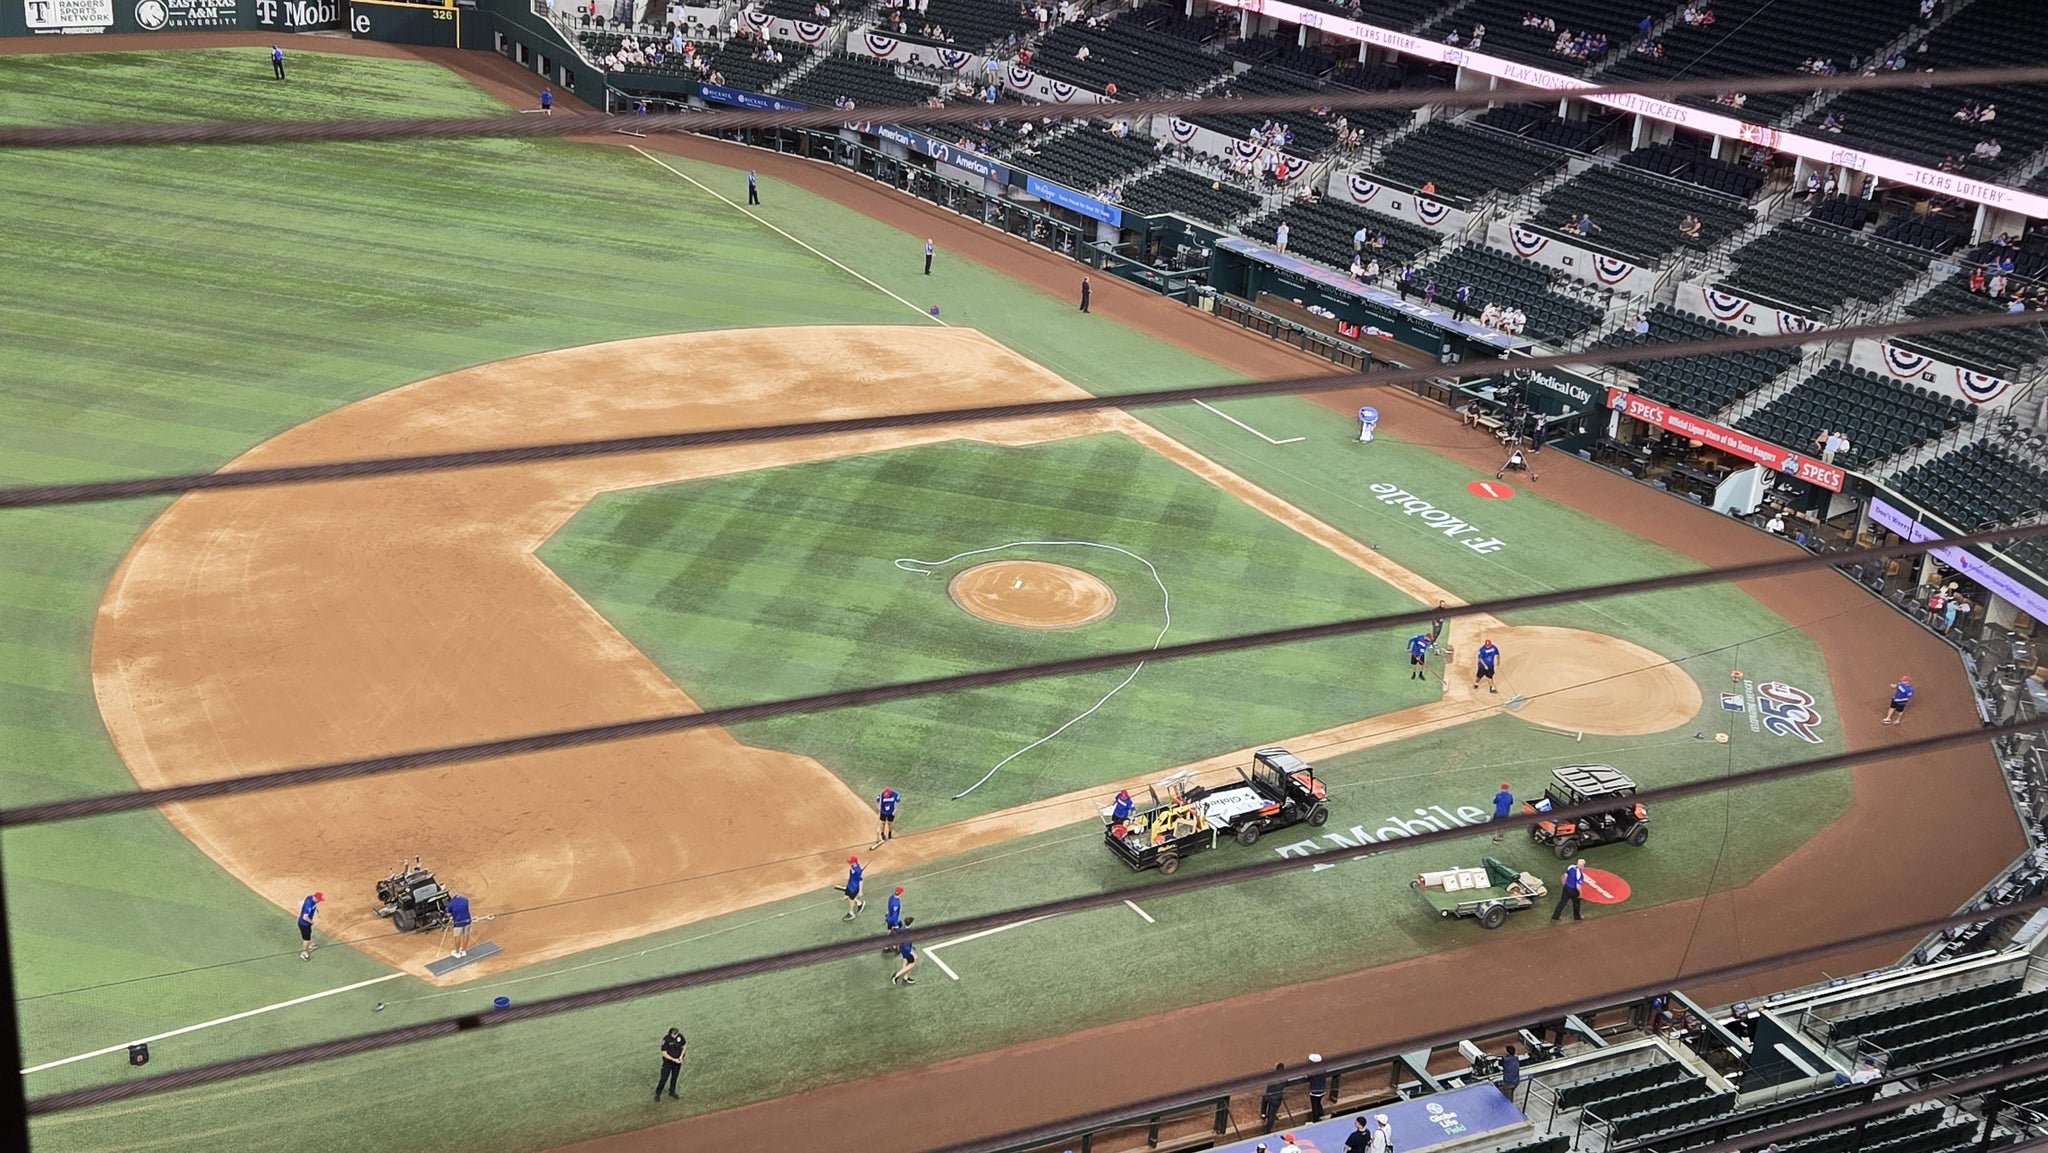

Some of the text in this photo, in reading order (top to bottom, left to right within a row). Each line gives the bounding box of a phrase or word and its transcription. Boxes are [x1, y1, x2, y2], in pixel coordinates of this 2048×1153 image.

[59, 0, 105, 8] RANGERS
[60, 7, 97, 15] SPORTS
[168, 0, 236, 8] EAST TEXAS
[60, 14, 110, 22] NETWORK
[187, 7, 218, 19] A&M
[432, 9, 453, 21] 326
[168, 18, 237, 27] UNIVERSITY
[1354, 28, 1415, 50] TEXAS LOTTERY
[1504, 64, 1531, 79] PLAY
[1638, 98, 1688, 123] TICKETS
[877, 125, 909, 146] American
[955, 154, 989, 176] American
[1914, 171, 2006, 202] TEXAS LOTTERY
[1530, 370, 1592, 405] Medical City
[1630, 401, 1664, 423] SPEC'S
[1687, 422, 1706, 439] Liquor
[1705, 428, 1720, 442] Store
[1720, 435, 1728, 444] of
[1727, 437, 1737, 449] the
[1737, 440, 1753, 454] Texas
[1753, 445, 1777, 463] Rangers
[1802, 463, 1841, 487] SPEC'S
[1369, 482, 1480, 537] Mobile
[1875, 506, 1891, 521] Don't
[1460, 537, 1507, 554] T
[1429, 1111, 1458, 1123] Globe
[1438, 1120, 1459, 1129] Life
[1444, 1124, 1467, 1136] Field
